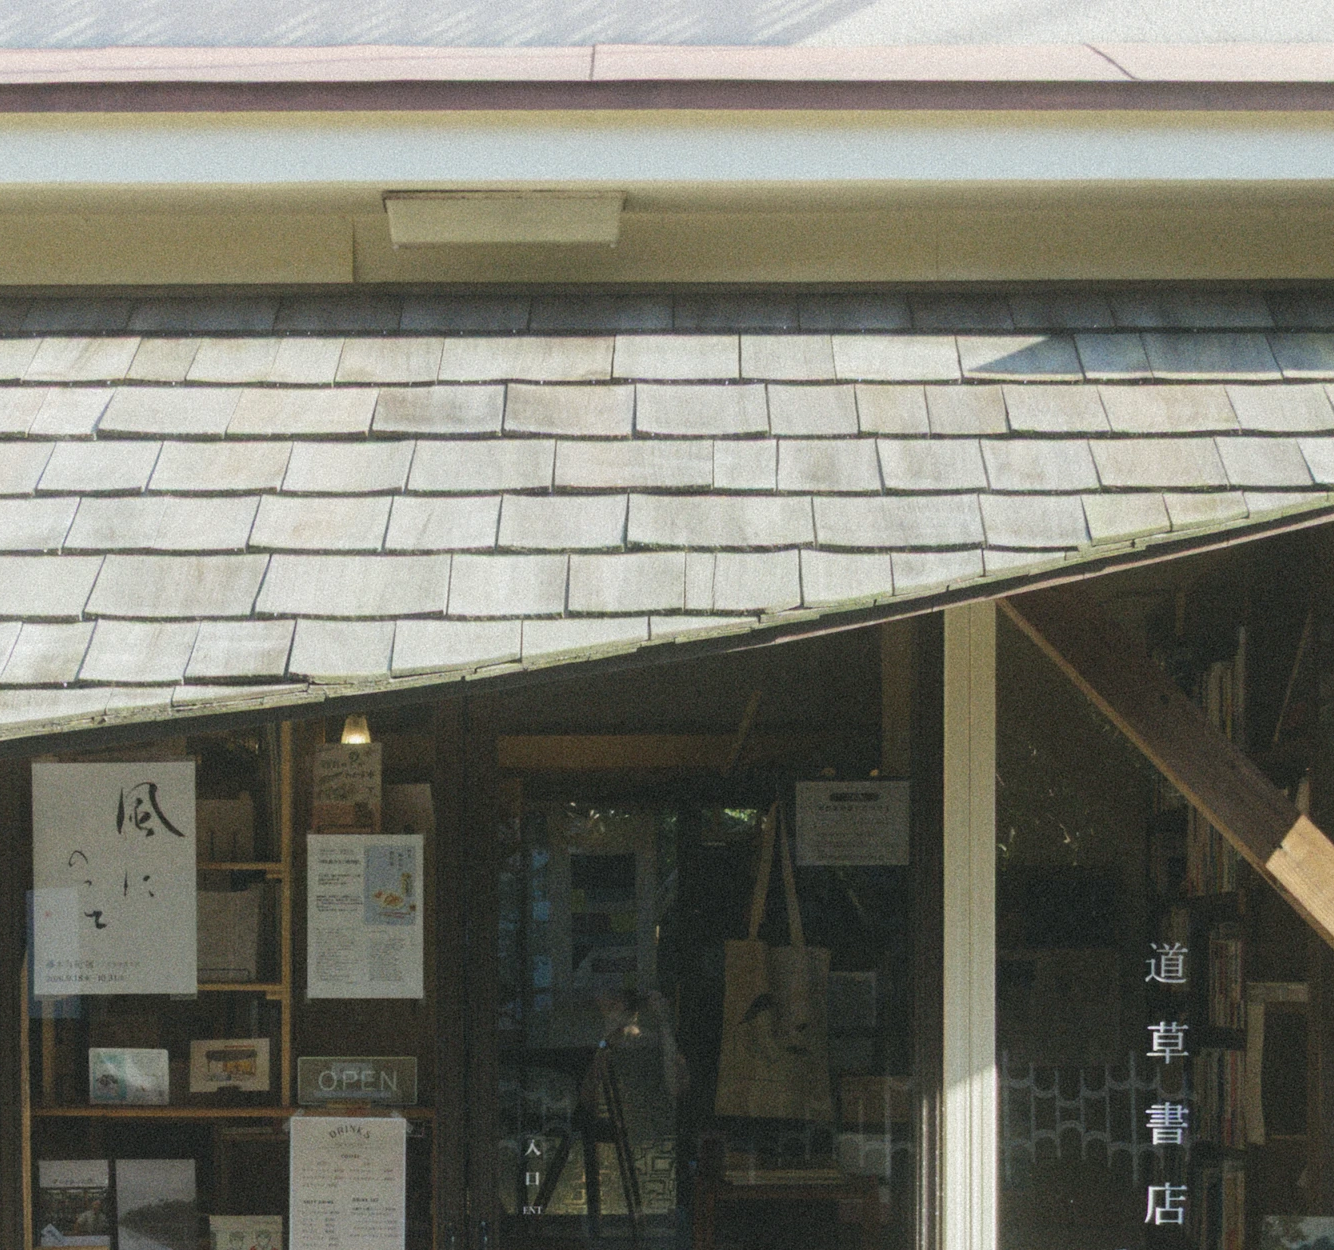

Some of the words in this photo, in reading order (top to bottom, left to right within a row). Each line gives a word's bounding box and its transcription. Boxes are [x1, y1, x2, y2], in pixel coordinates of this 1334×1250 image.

[317, 1069, 398, 1092] OPEN
[1145, 942, 1189, 1225] 道草書店
[328, 1124, 371, 1140] DRINKS
[525, 1139, 541, 1186] 入口
